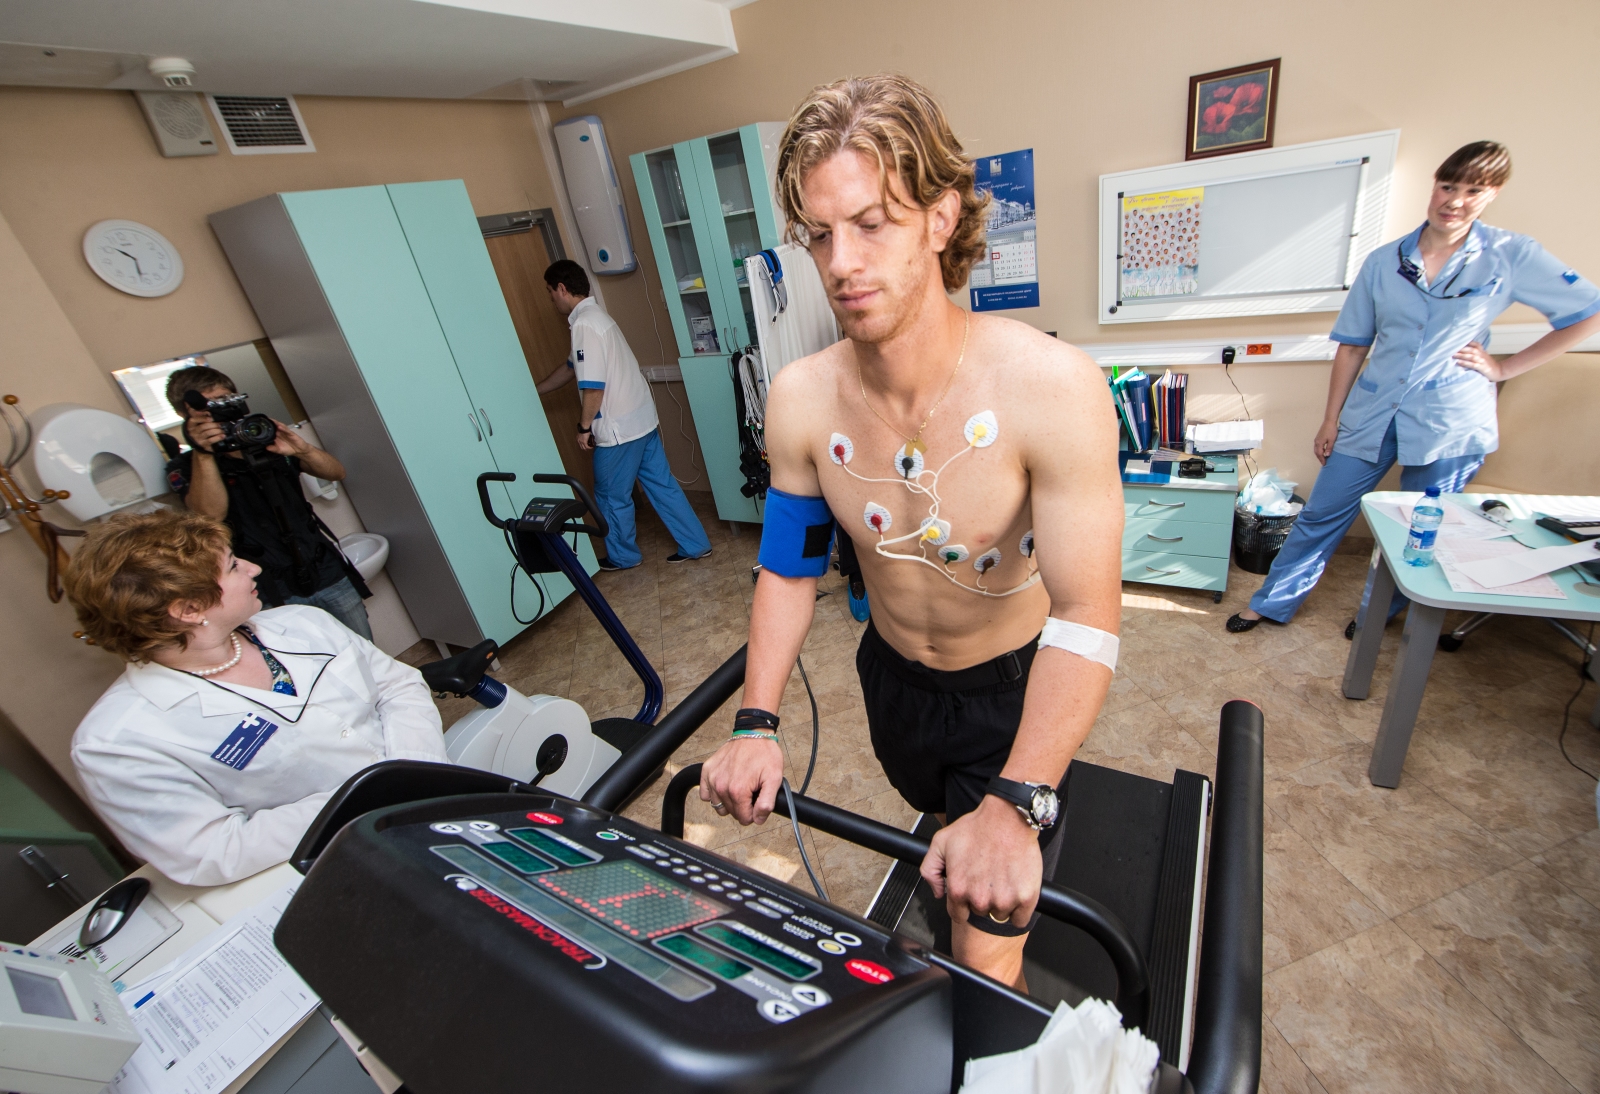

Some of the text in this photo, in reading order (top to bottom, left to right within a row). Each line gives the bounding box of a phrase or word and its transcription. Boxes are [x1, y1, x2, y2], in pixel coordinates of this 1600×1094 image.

[534, 813, 557, 824] STOP
[555, 836, 583, 850] TIME
[470, 889, 592, 963] TRACKMASTER
[732, 922, 812, 964] DISTANCE
[851, 961, 890, 983] STOP
